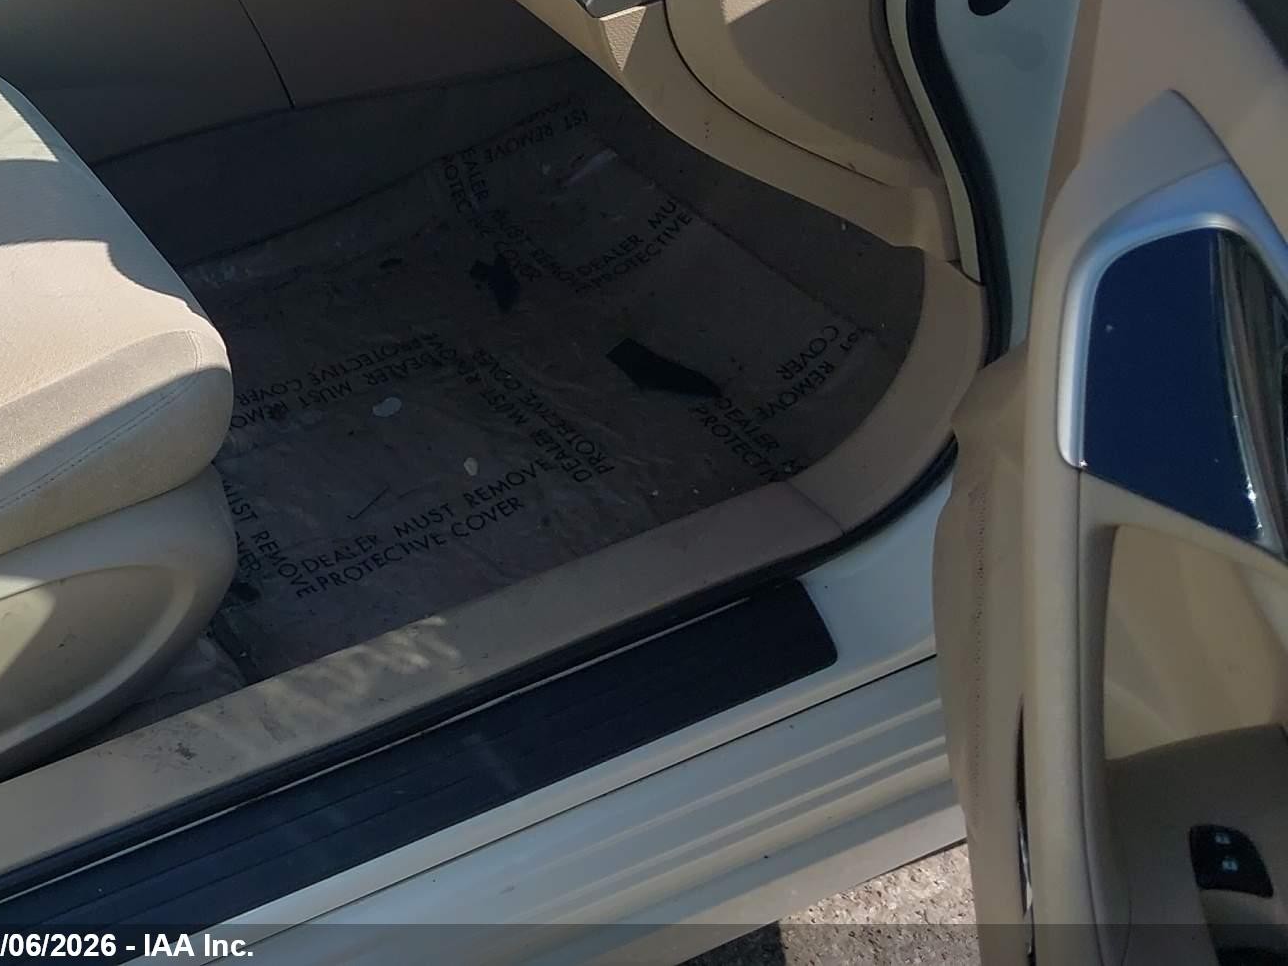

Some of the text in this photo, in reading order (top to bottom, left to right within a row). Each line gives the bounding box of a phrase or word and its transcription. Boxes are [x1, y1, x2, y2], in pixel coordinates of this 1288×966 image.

[776, 325, 840, 380] COVER
[237, 378, 303, 407] COVER
[298, 380, 353, 409] MUST
[479, 387, 531, 427] MUST
[753, 360, 835, 422] REMOVE
[301, 457, 559, 576] DEALER MUST REMOVE
[315, 495, 527, 592] PROTECTIVE COVER
[253, 529, 316, 598] REMOVE
